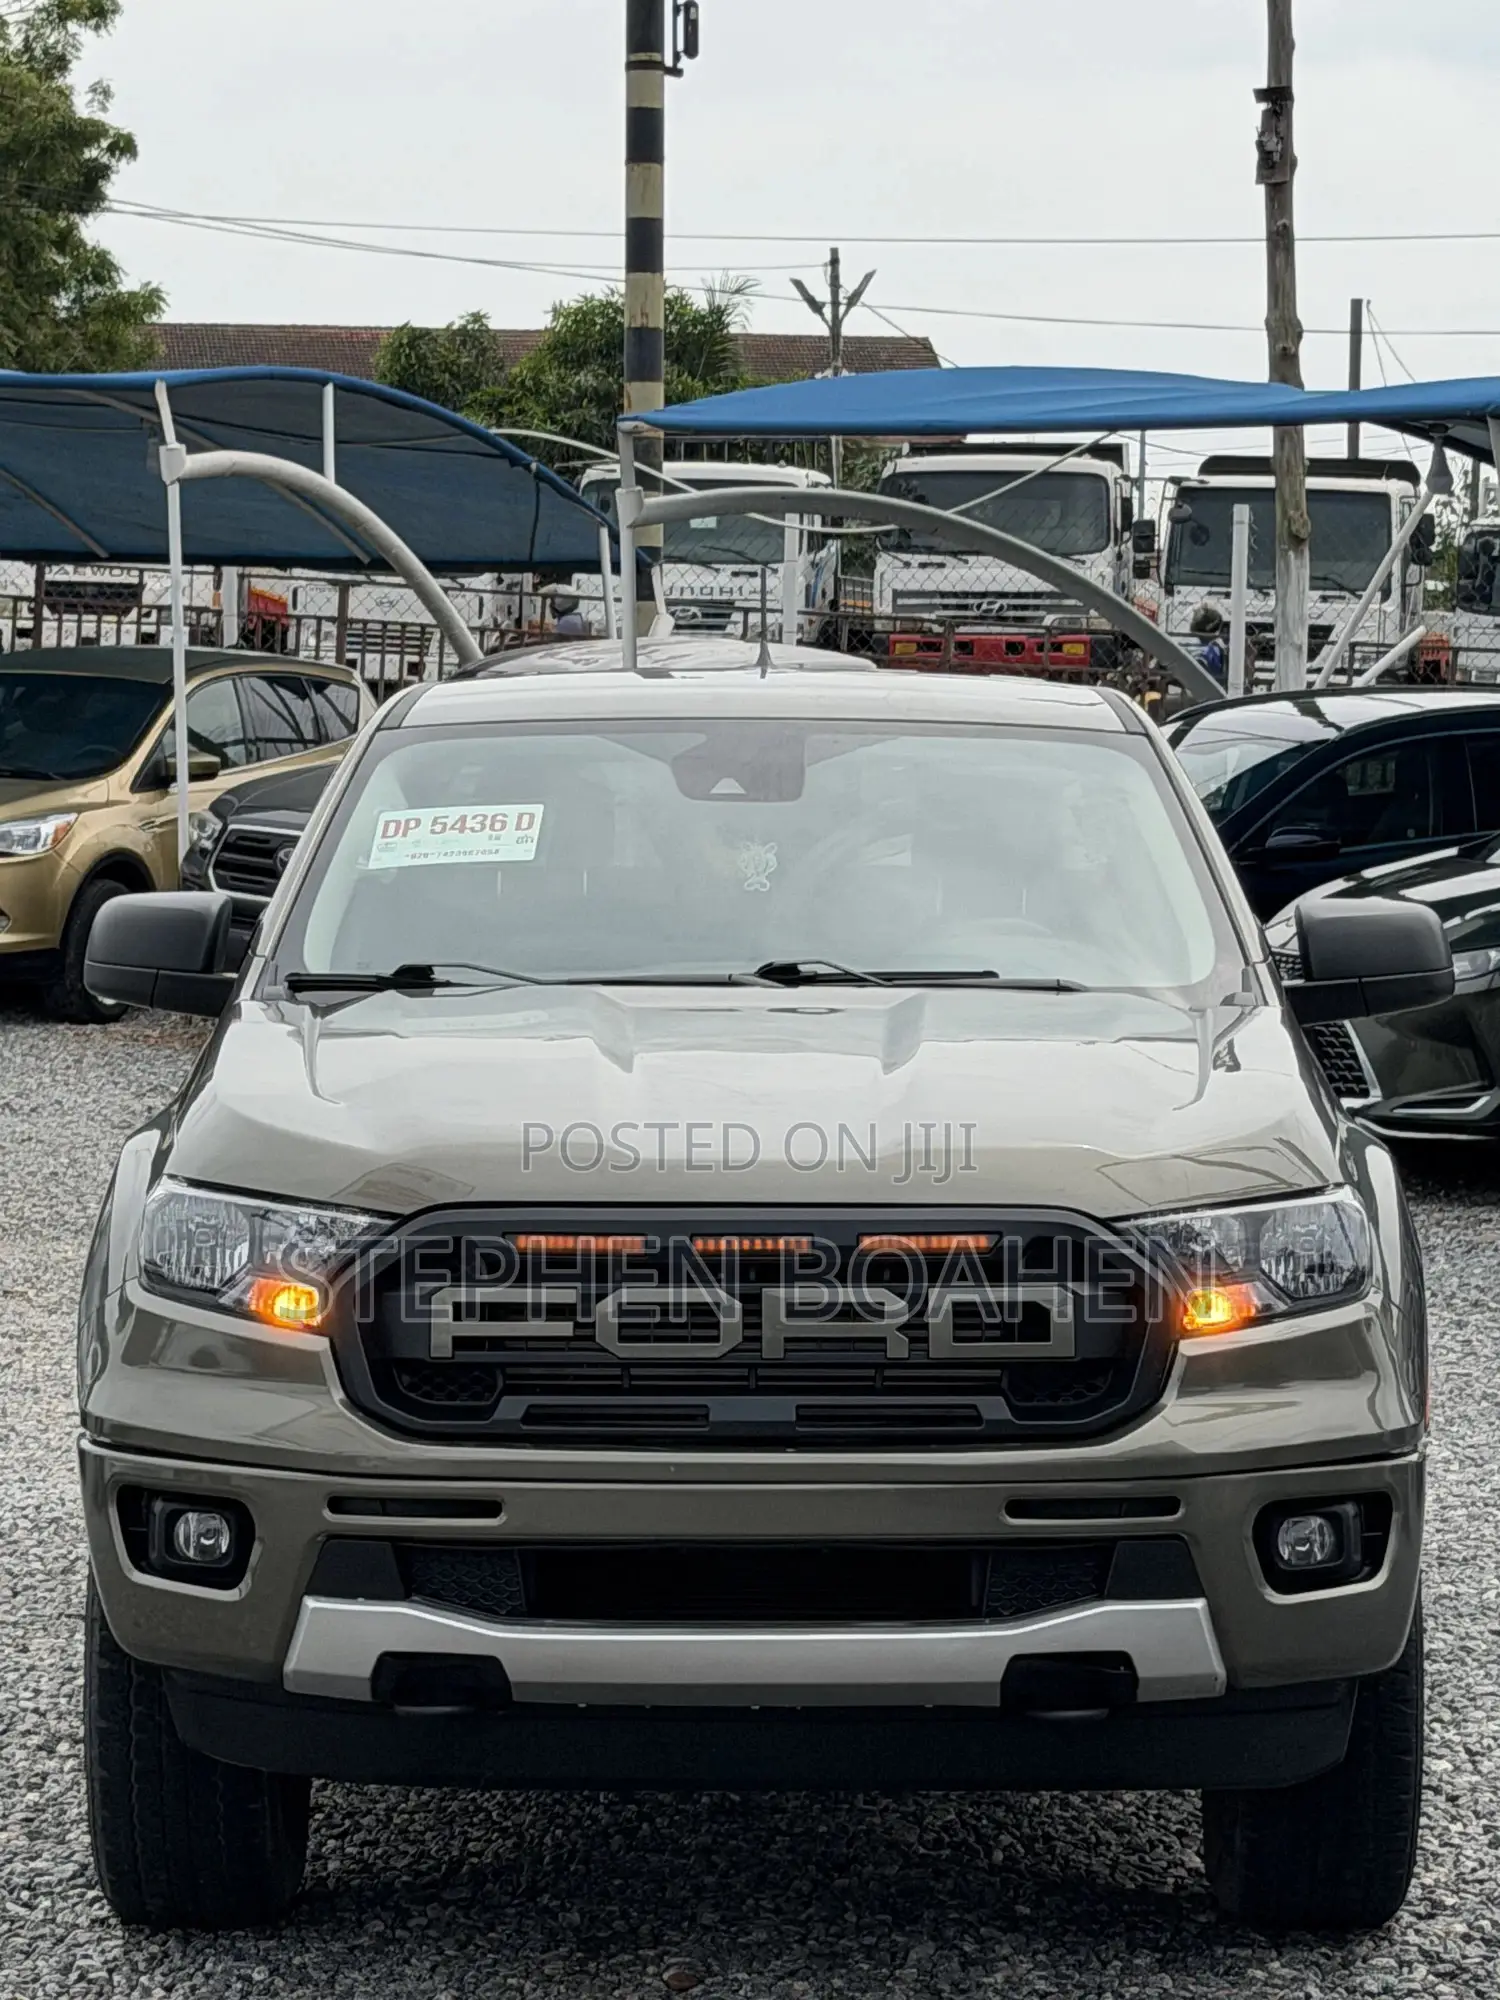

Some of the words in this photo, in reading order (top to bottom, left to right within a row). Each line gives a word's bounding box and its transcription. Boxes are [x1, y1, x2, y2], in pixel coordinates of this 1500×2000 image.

[663, 585, 743, 597] UNDAI
[380, 817, 422, 839] DP
[430, 812, 508, 835] 5436
[514, 812, 536, 831] D
[430, 1286, 1076, 1359] FORD
